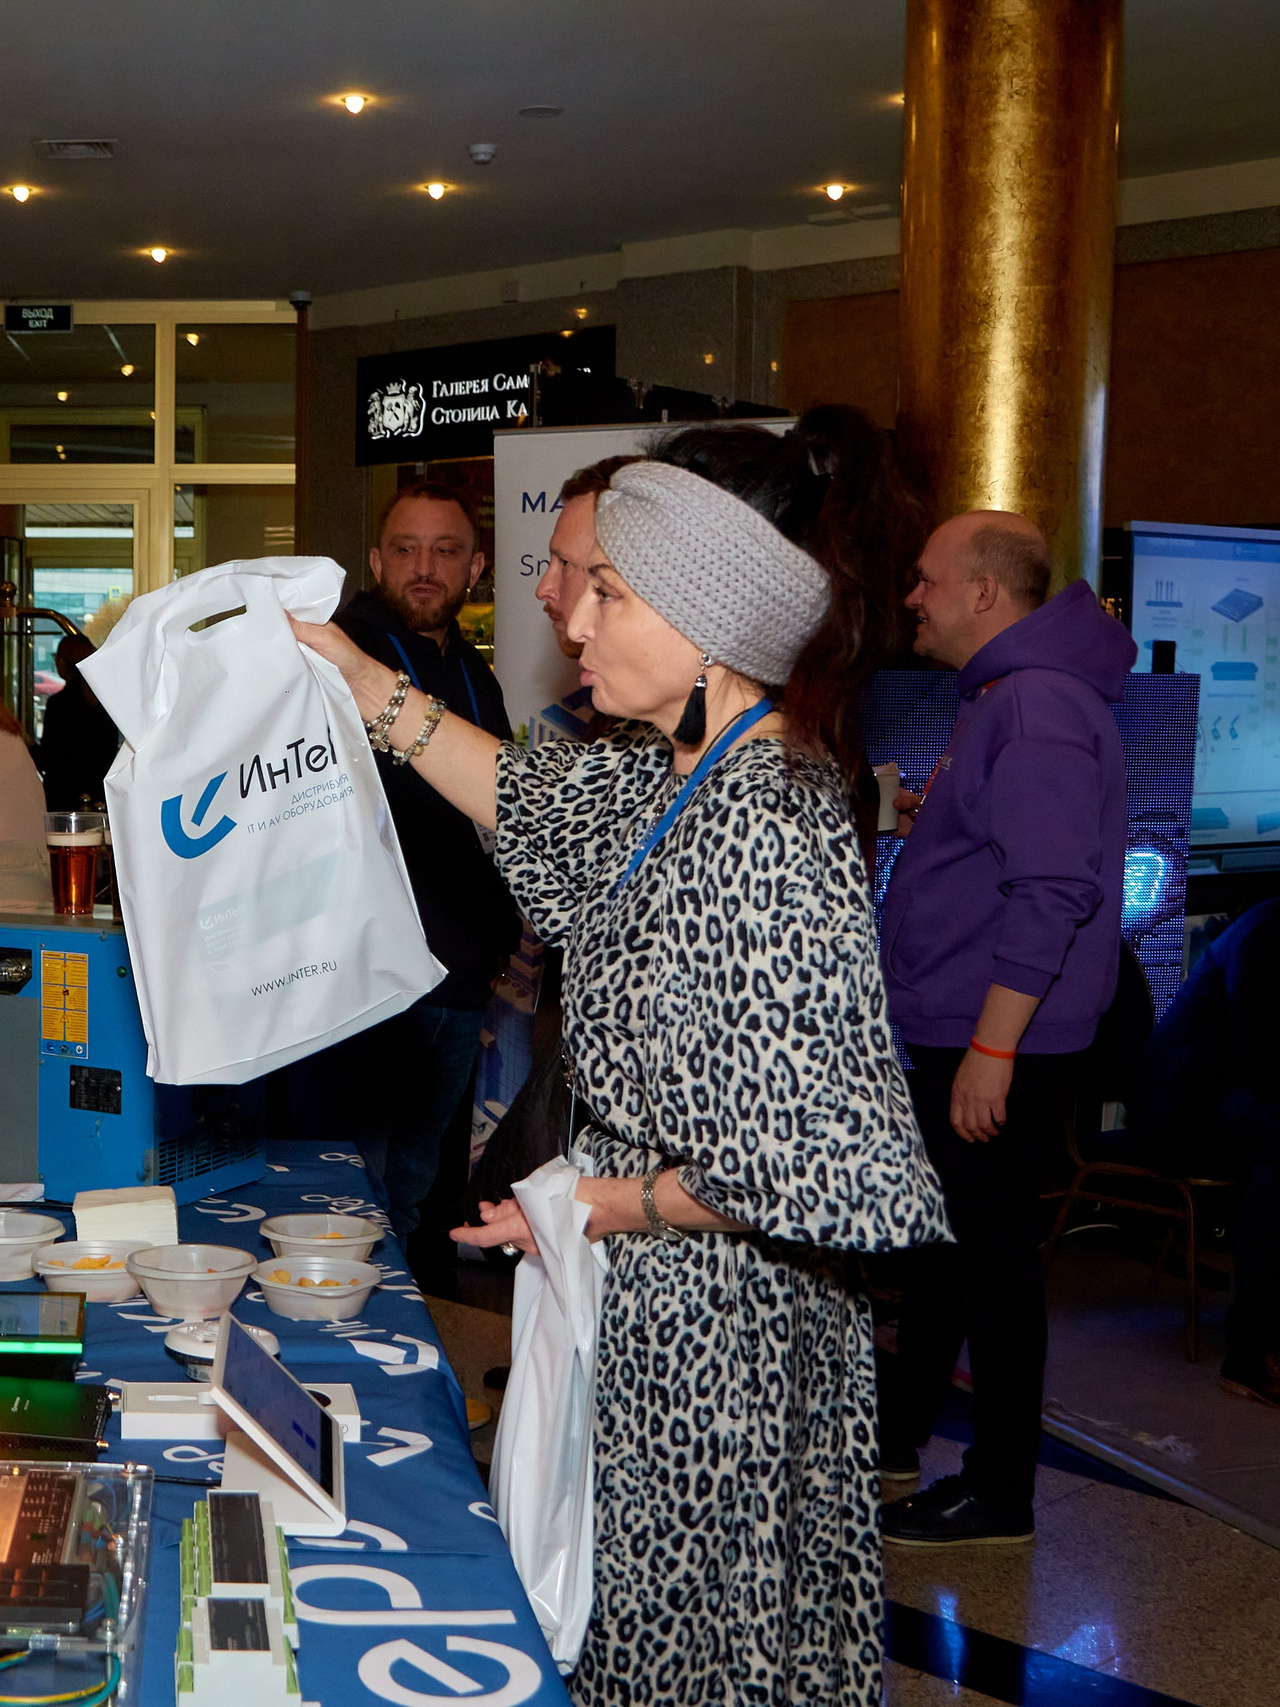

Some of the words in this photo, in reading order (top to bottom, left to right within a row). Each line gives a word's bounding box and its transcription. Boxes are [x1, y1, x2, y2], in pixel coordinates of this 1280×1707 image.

[22, 308, 54, 319] ВЫХОД
[28, 319, 48, 328] EXIT
[251, 960, 338, 997] WWW.INTER.RU
